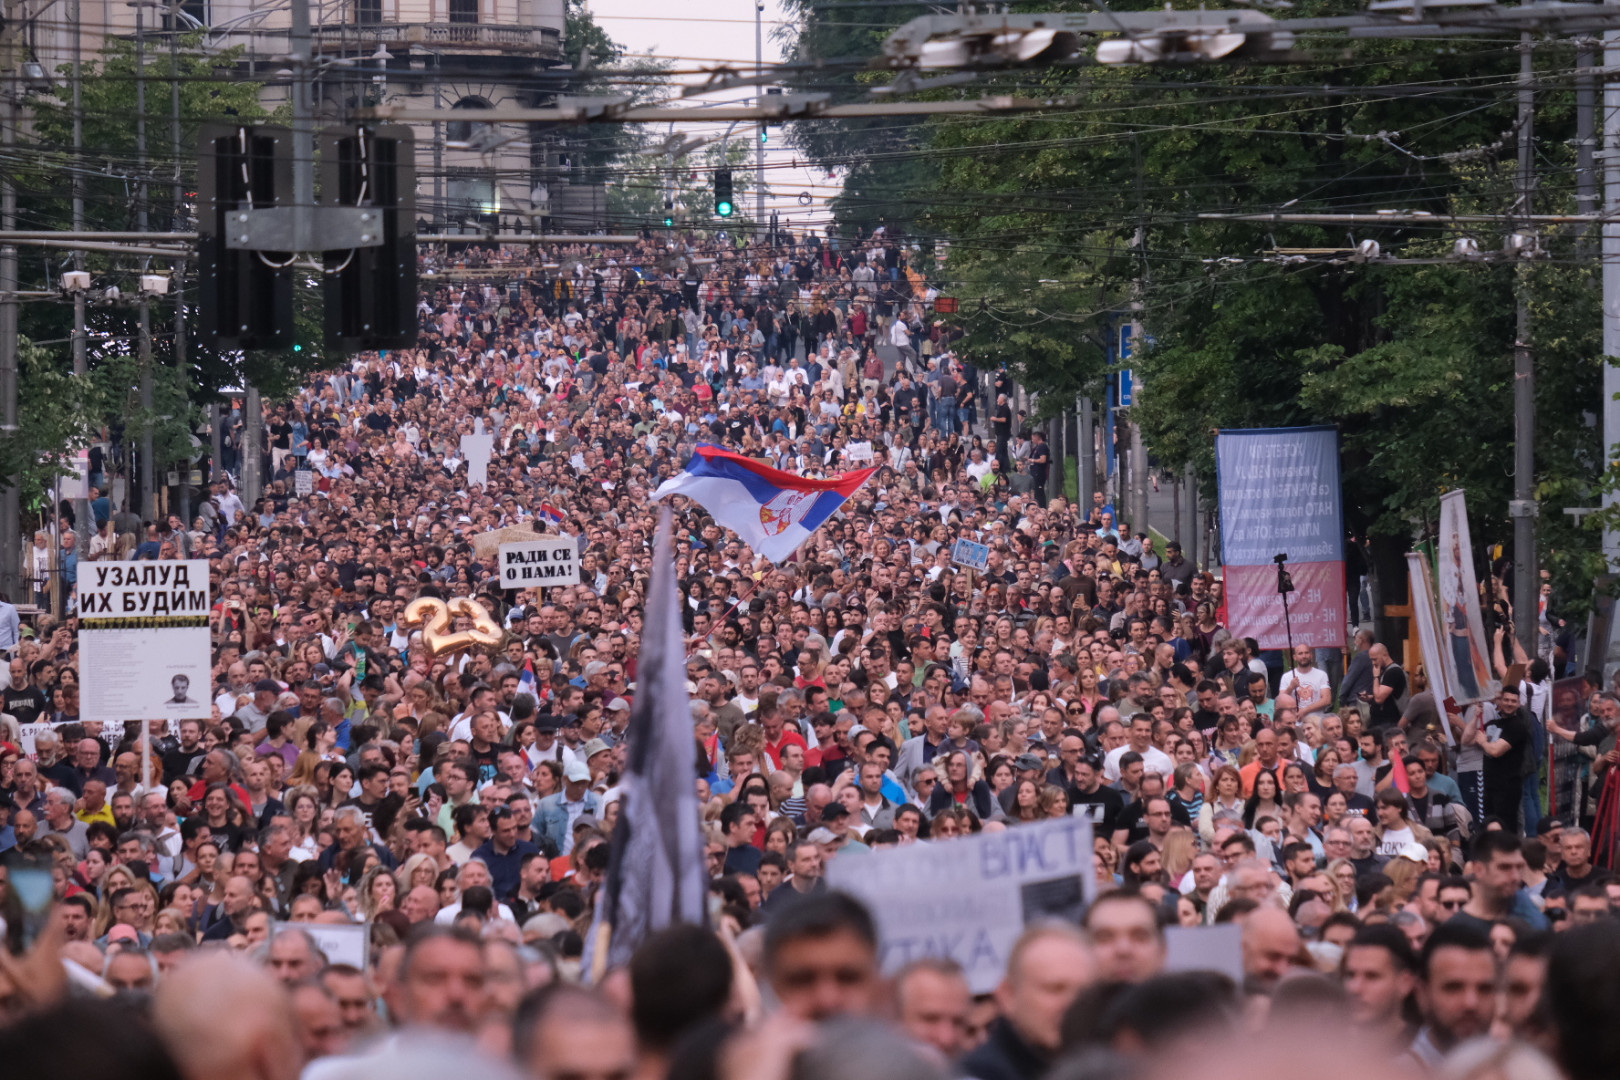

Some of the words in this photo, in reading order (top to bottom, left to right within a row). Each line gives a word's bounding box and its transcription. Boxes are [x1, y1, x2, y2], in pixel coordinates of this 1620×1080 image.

[506, 550, 548, 565] РАДИ
[552, 548, 571, 561] СЕ
[96, 565, 190, 589] УЗАЛУД
[506, 567, 517, 580] О
[521, 564, 572, 579] НАМА!
[81, 592, 113, 613] ИХ
[122, 591, 206, 615] БУДИМ
[404, 596, 502, 658] 23
[1382, 841, 1406, 855] TOKY
